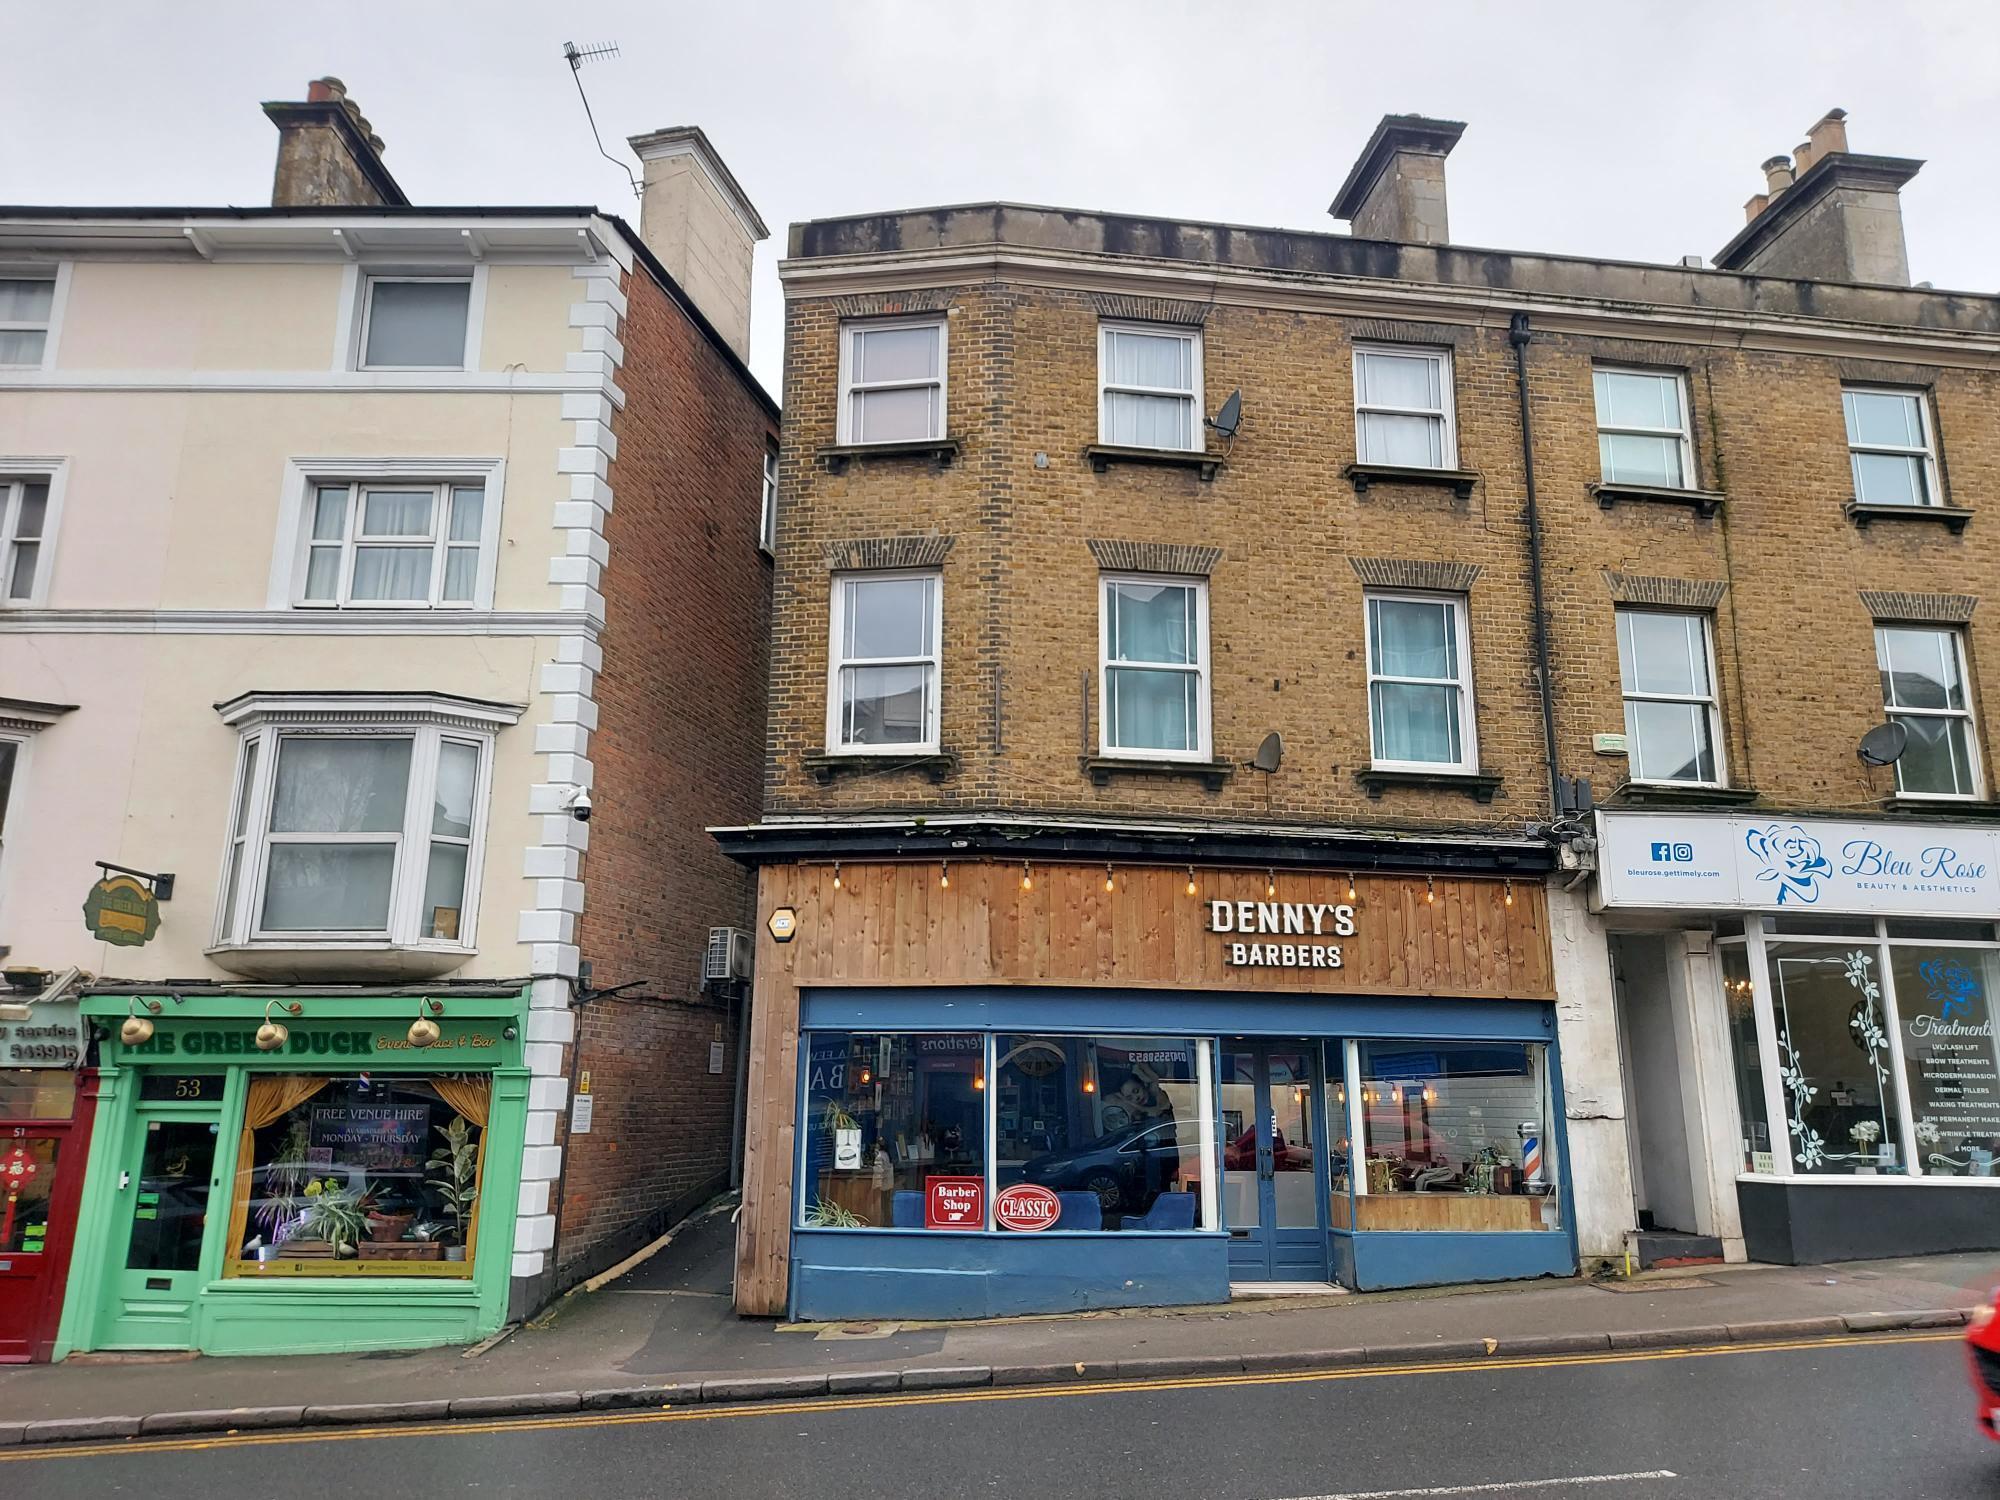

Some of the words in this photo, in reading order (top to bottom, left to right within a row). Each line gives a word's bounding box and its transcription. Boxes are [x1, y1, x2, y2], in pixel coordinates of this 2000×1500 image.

[1841, 840, 1913, 876] Bleu
[1920, 847, 1987, 879] Rose
[1627, 868, 1720, 877] bleurose.gettimely.com
[1856, 882, 1897, 890] BEAUTY
[1913, 884, 1977, 893] AESTHETICS
[1211, 900, 1355, 936] DENNY'S
[1231, 943, 1341, 968] BARBERS
[15, 1023, 77, 1039] service
[1909, 1014, 1994, 1038] Treatments
[290, 1031, 374, 1055] DUCK
[471, 1034, 496, 1048] Bar
[1932, 1043, 1964, 1051] LVL/LASH
[1947, 1058, 1990, 1066] TREATMENTS
[1923, 1072, 1997, 1080] MICRODERMABRASION
[175, 1078, 201, 1098] 53
[1934, 1086, 1962, 1094] DERMAL
[316, 1108, 347, 1120] FREE
[350, 1108, 391, 1120] VENUE
[394, 1109, 424, 1121] HIRE
[13, 1127, 25, 1138] 51
[322, 1133, 362, 1143] MONDAY
[371, 1134, 421, 1144] THURSDAY
[1960, 1145, 1981, 1153] MORE
[938, 1186, 977, 1197] Barber
[943, 1199, 971, 1213] Shop
[1000, 1198, 1053, 1217] CLASSIC
